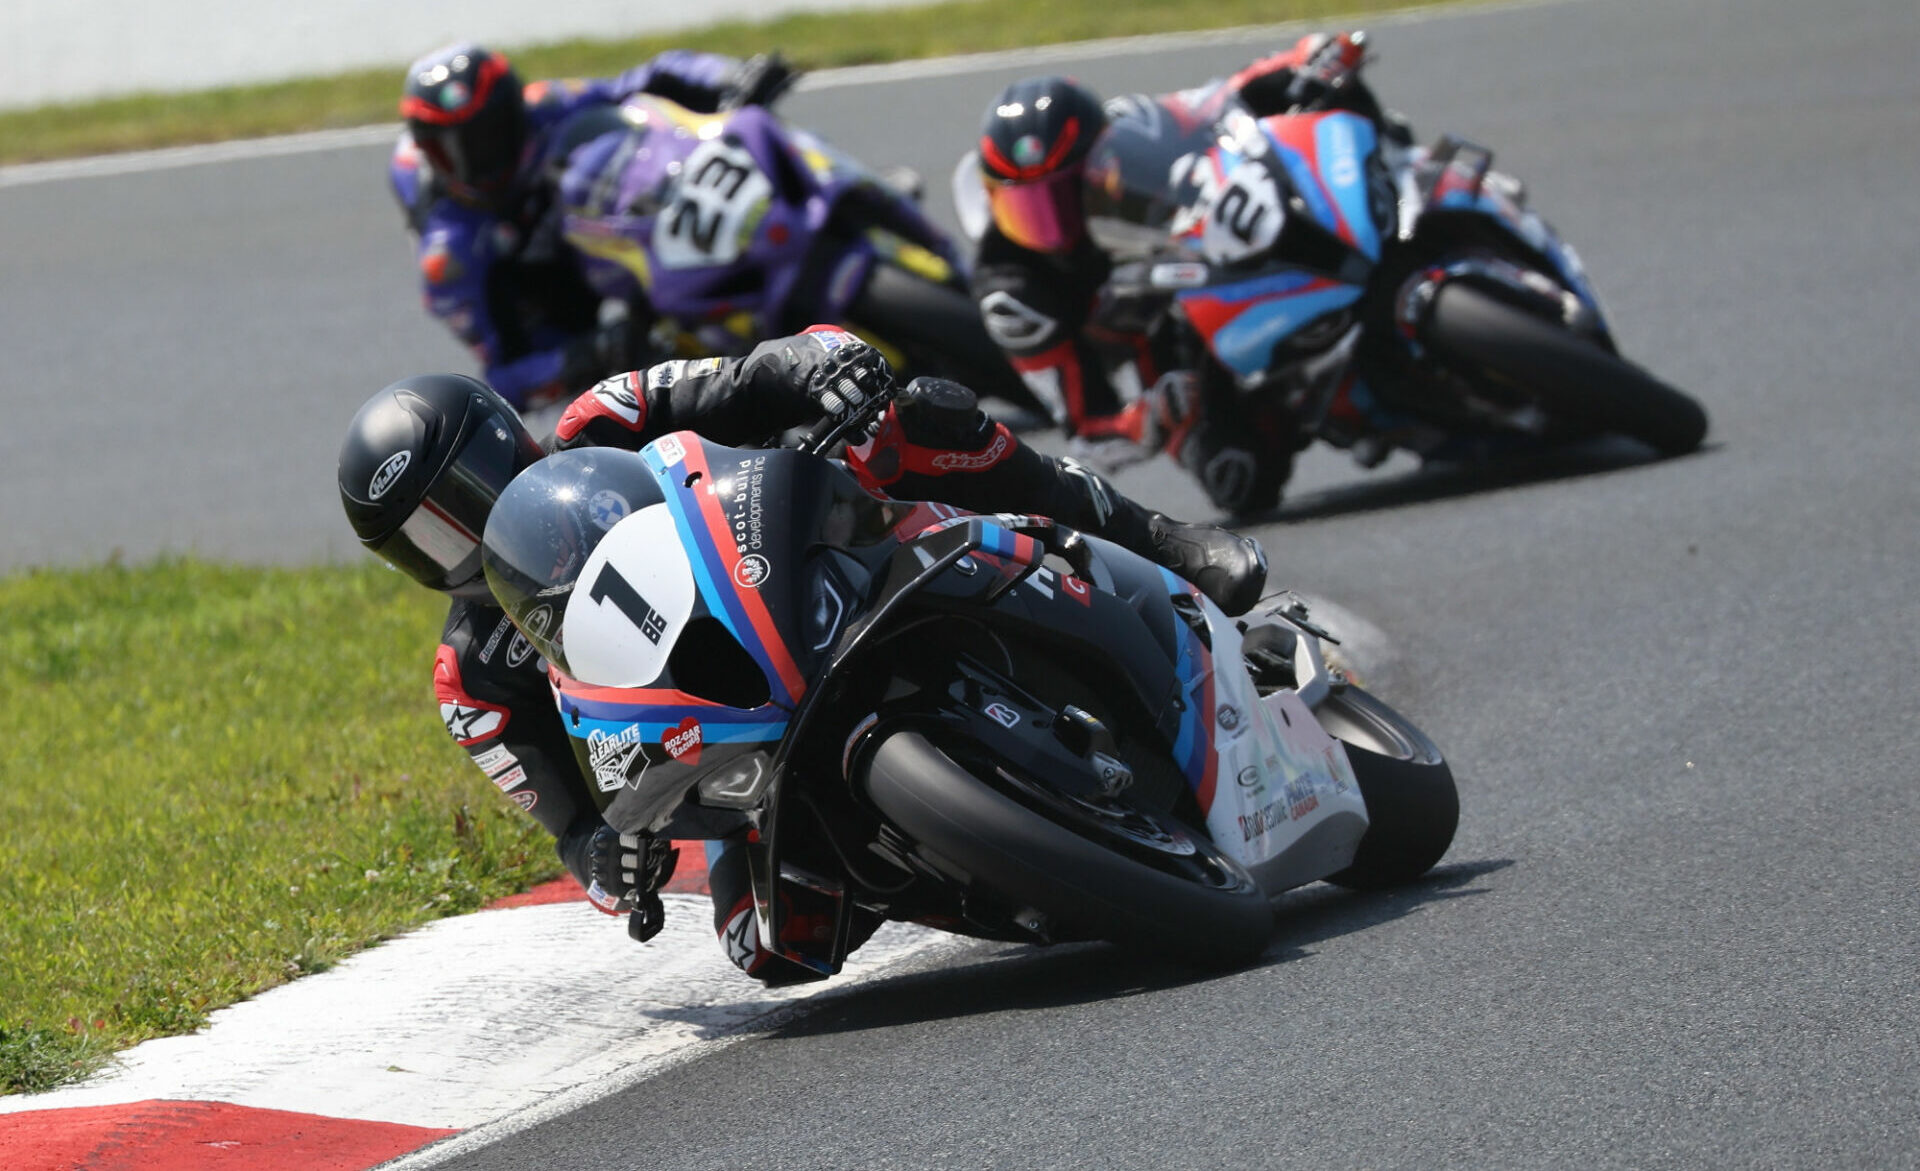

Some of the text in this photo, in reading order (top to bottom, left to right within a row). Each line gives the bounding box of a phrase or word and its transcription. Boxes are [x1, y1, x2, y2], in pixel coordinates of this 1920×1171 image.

[669, 155, 751, 256] 23
[1214, 184, 1265, 246] 2
[371, 452, 406, 497] HJC
[733, 458, 752, 553] scot-build
[748, 455, 766, 550] developments inc
[589, 560, 652, 630] 1
[641, 608, 668, 646] 86
[589, 723, 640, 767] CLEARLITE
[664, 724, 701, 752] ROZ-GAR
